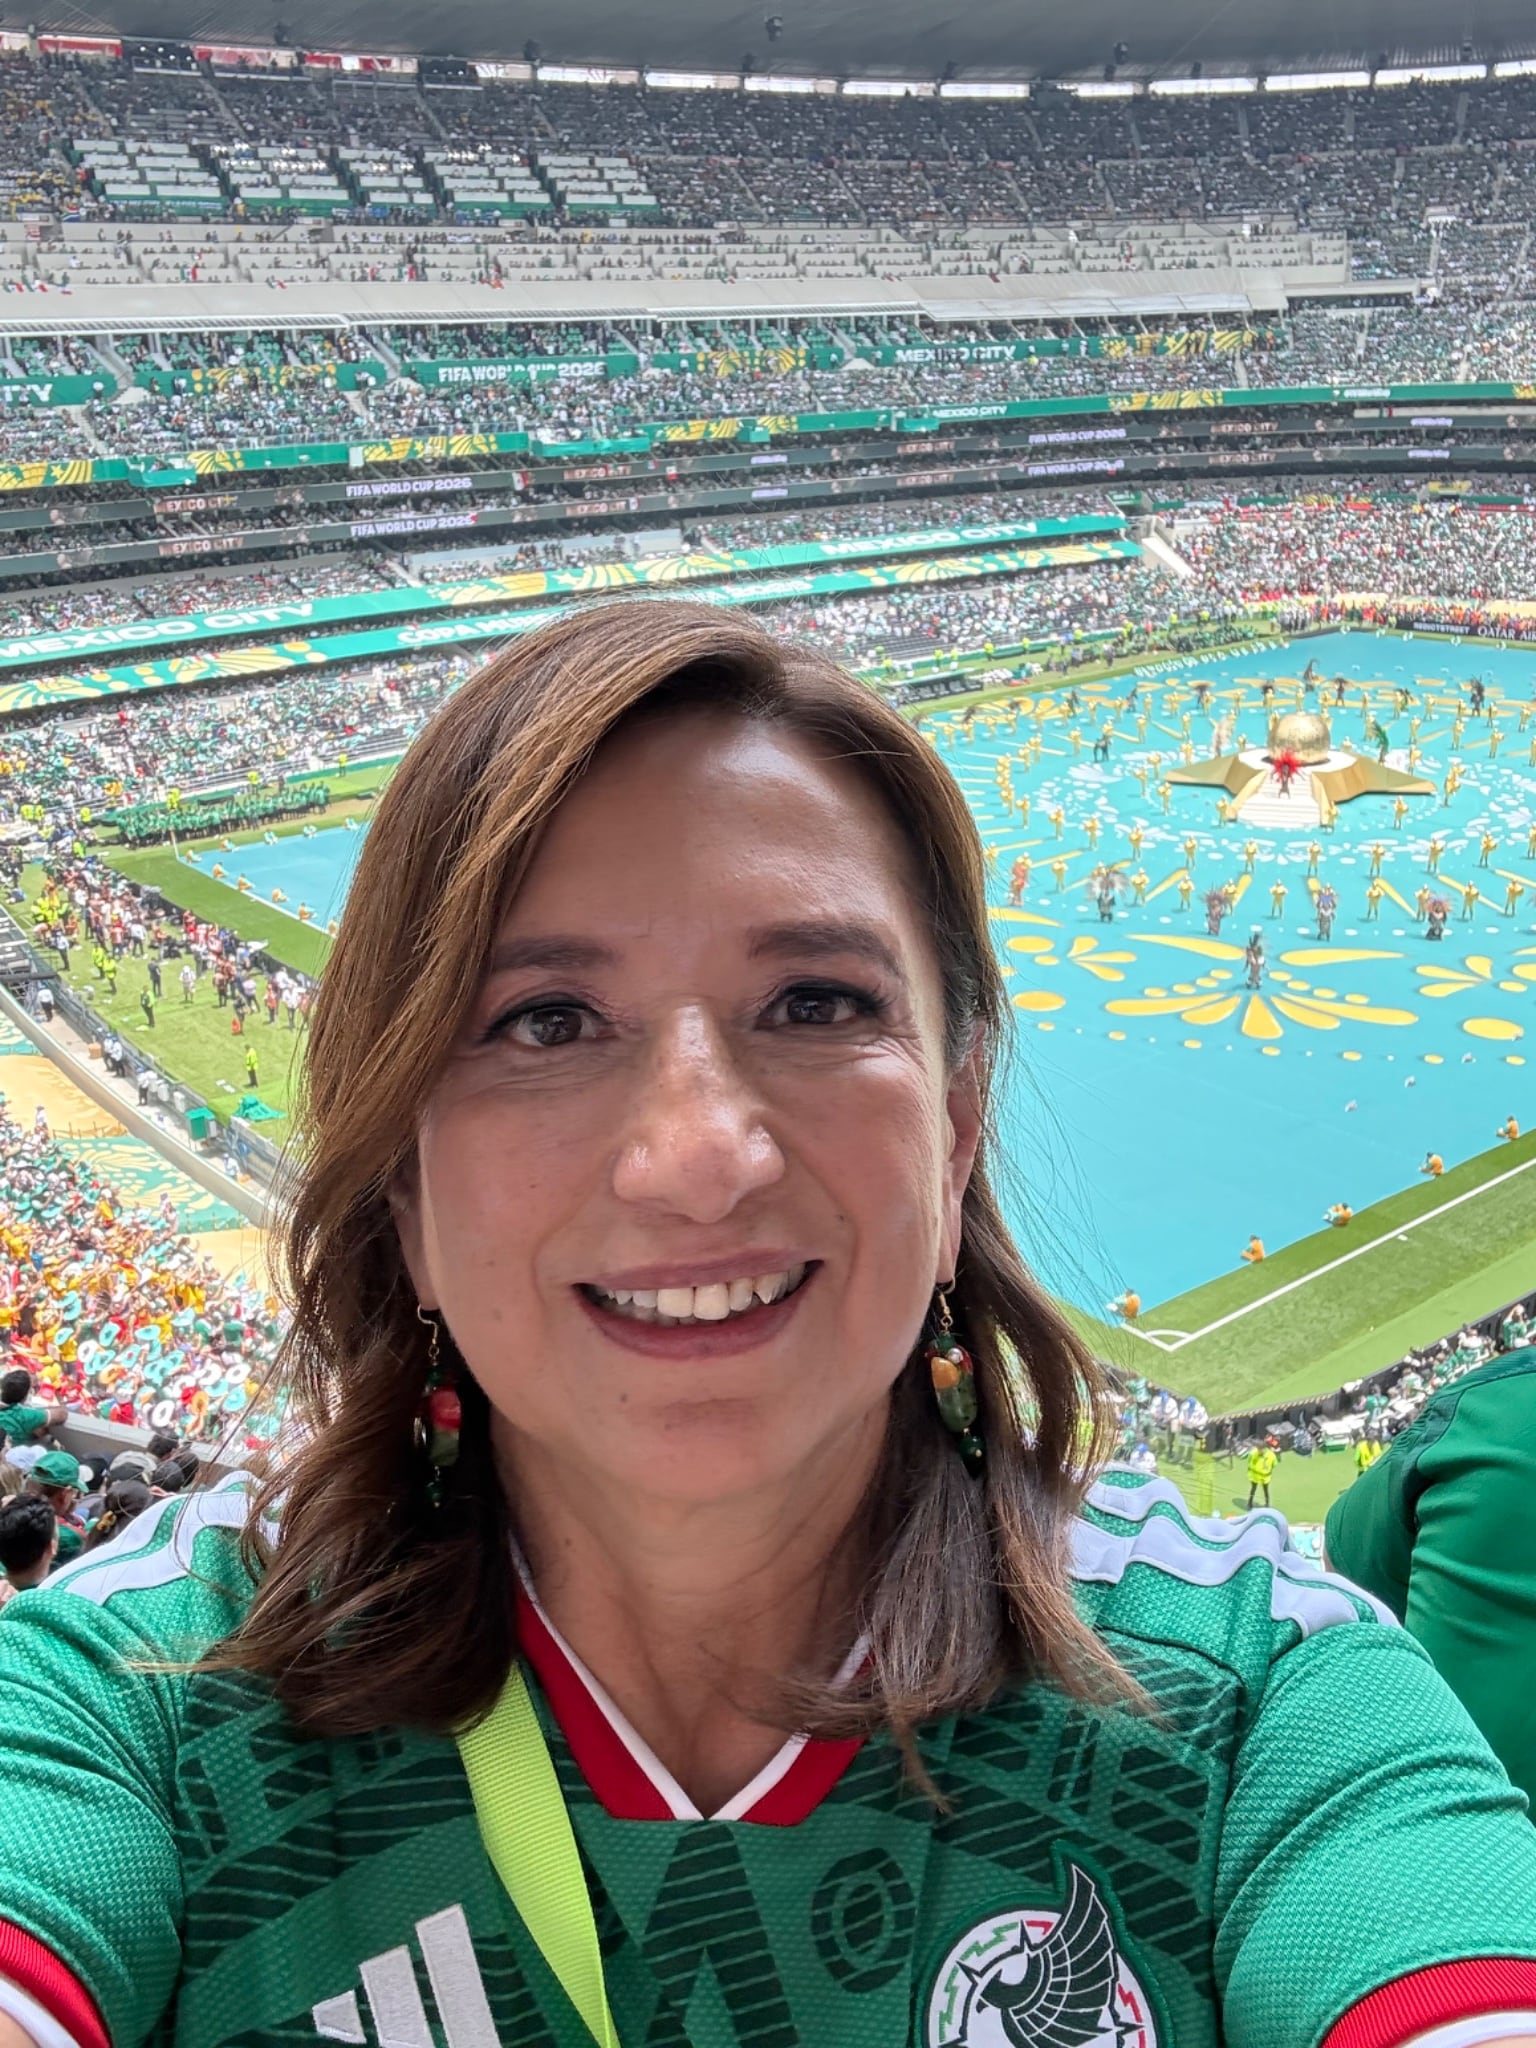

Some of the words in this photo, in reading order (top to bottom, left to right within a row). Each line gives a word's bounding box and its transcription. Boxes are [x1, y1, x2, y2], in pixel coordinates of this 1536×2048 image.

[972, 345, 1016, 360] CITY
[438, 367, 471, 383] FIFA
[979, 405, 1008, 416] CITY
[345, 484, 371, 498] FIFA
[371, 480, 412, 496] WORLD
[412, 479, 434, 493] CUP
[434, 476, 473, 490] 2026
[351, 523, 376, 538] FIFA
[376, 520, 415, 536] WORLD
[416, 518, 438, 532] CUP
[159, 540, 212, 557] MEXICO
[213, 537, 244, 552] CITY
[820, 531, 961, 555] MEXICO
[961, 522, 1038, 540] CITY
[0, 620, 197, 657] MEXICO
[203, 603, 313, 629] CITY
[398, 623, 481, 645] COPA
[1477, 625, 1516, 640] QATAR
